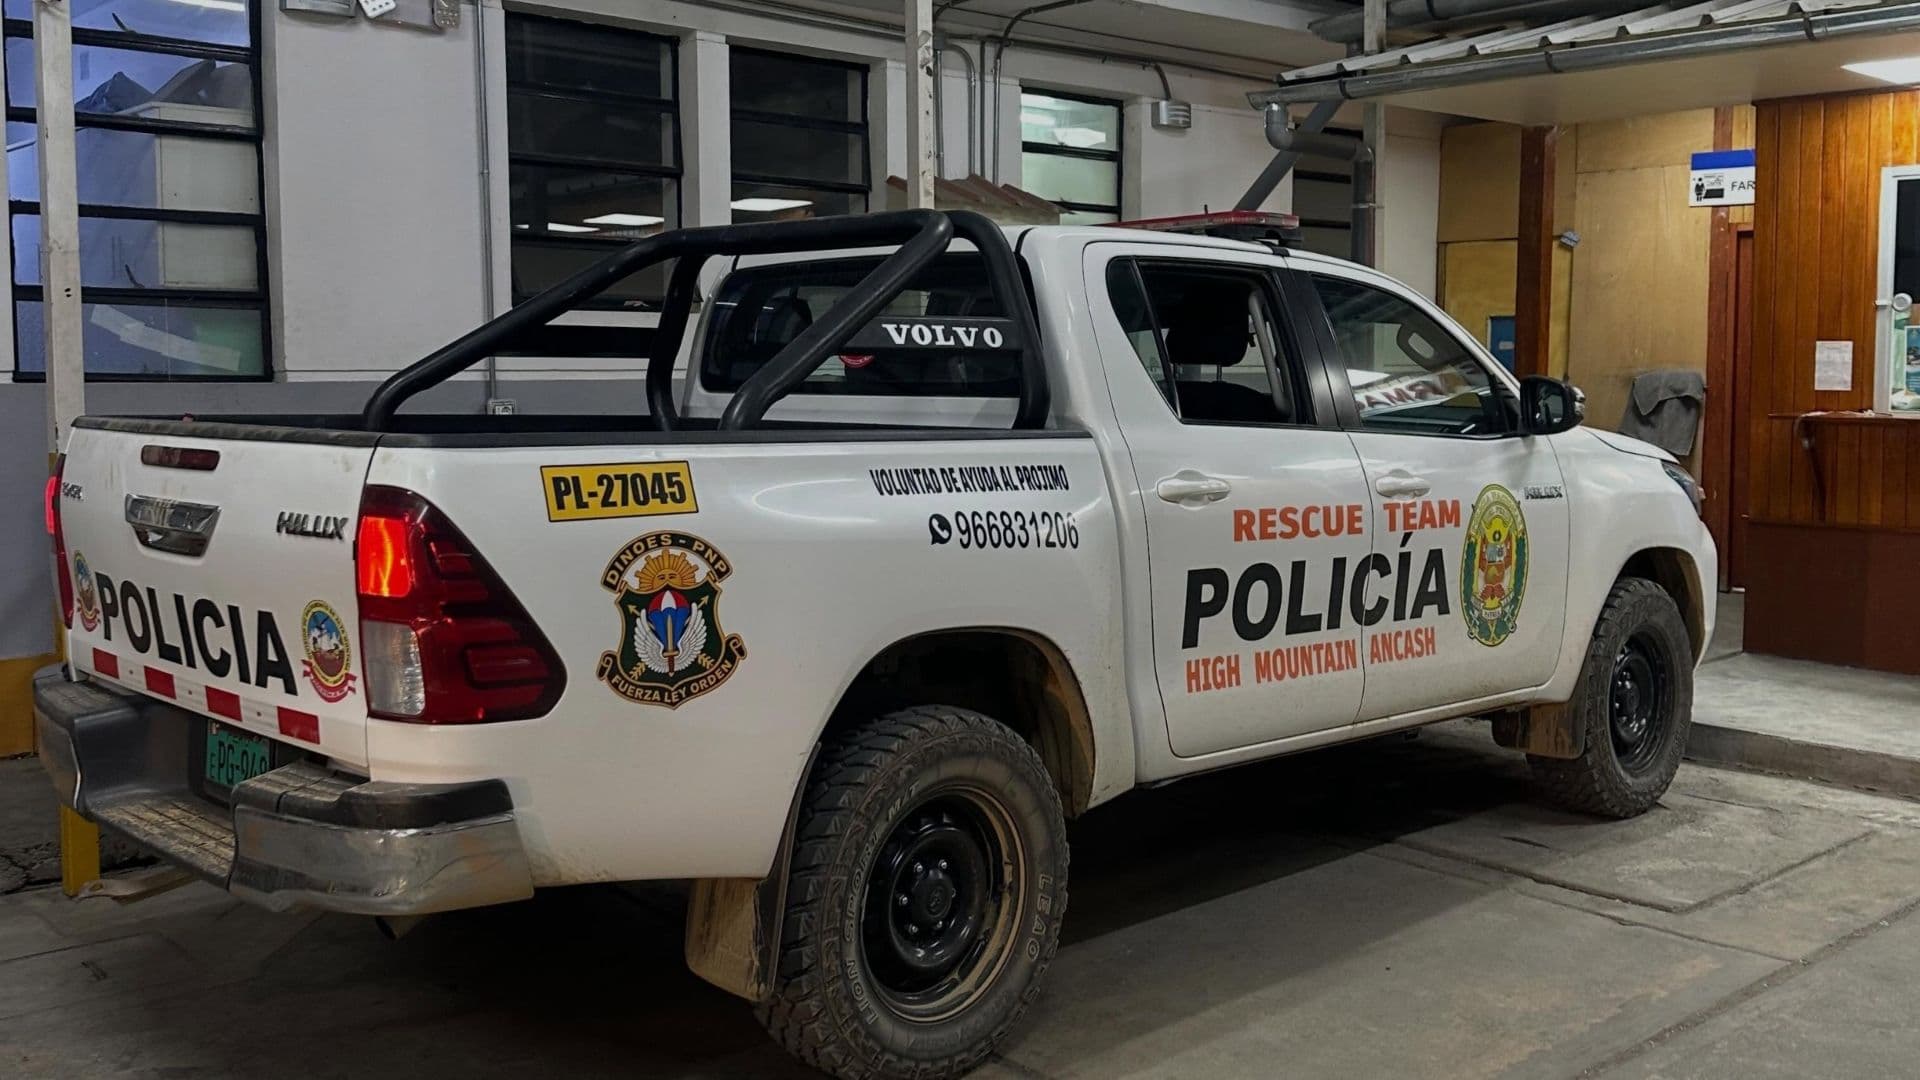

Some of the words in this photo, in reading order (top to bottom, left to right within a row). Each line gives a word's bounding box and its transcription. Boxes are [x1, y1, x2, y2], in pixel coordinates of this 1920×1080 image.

[882, 323, 1003, 348] VOLVO
[552, 471, 687, 511] PL-27045
[869, 468, 942, 496] VOLUNTAD
[940, 467, 960, 493] DE
[958, 465, 1002, 493] AYUDA
[1000, 466, 1019, 492] AL
[1015, 464, 1070, 491] PROJIMO
[276, 511, 349, 540] HILUX
[955, 510, 1079, 550] 966831206
[1233, 504, 1363, 542] RESCUE
[1383, 499, 1461, 532] TEAM
[605, 534, 672, 587] DINOES
[692, 540, 728, 575] PNP
[1181, 531, 1451, 649] POLICÍA
[95, 572, 299, 697] POLICIA
[611, 675, 660, 702] FUERZA
[664, 690, 686, 704] LEY
[690, 659, 733, 692] ORDEN
[1186, 654, 1241, 694] HIGH
[1254, 639, 1357, 684] MOUNTAIN
[1370, 626, 1436, 665] ANCASH
[1026, 873, 1053, 962] LEAO
[846, 959, 878, 1025] LION
